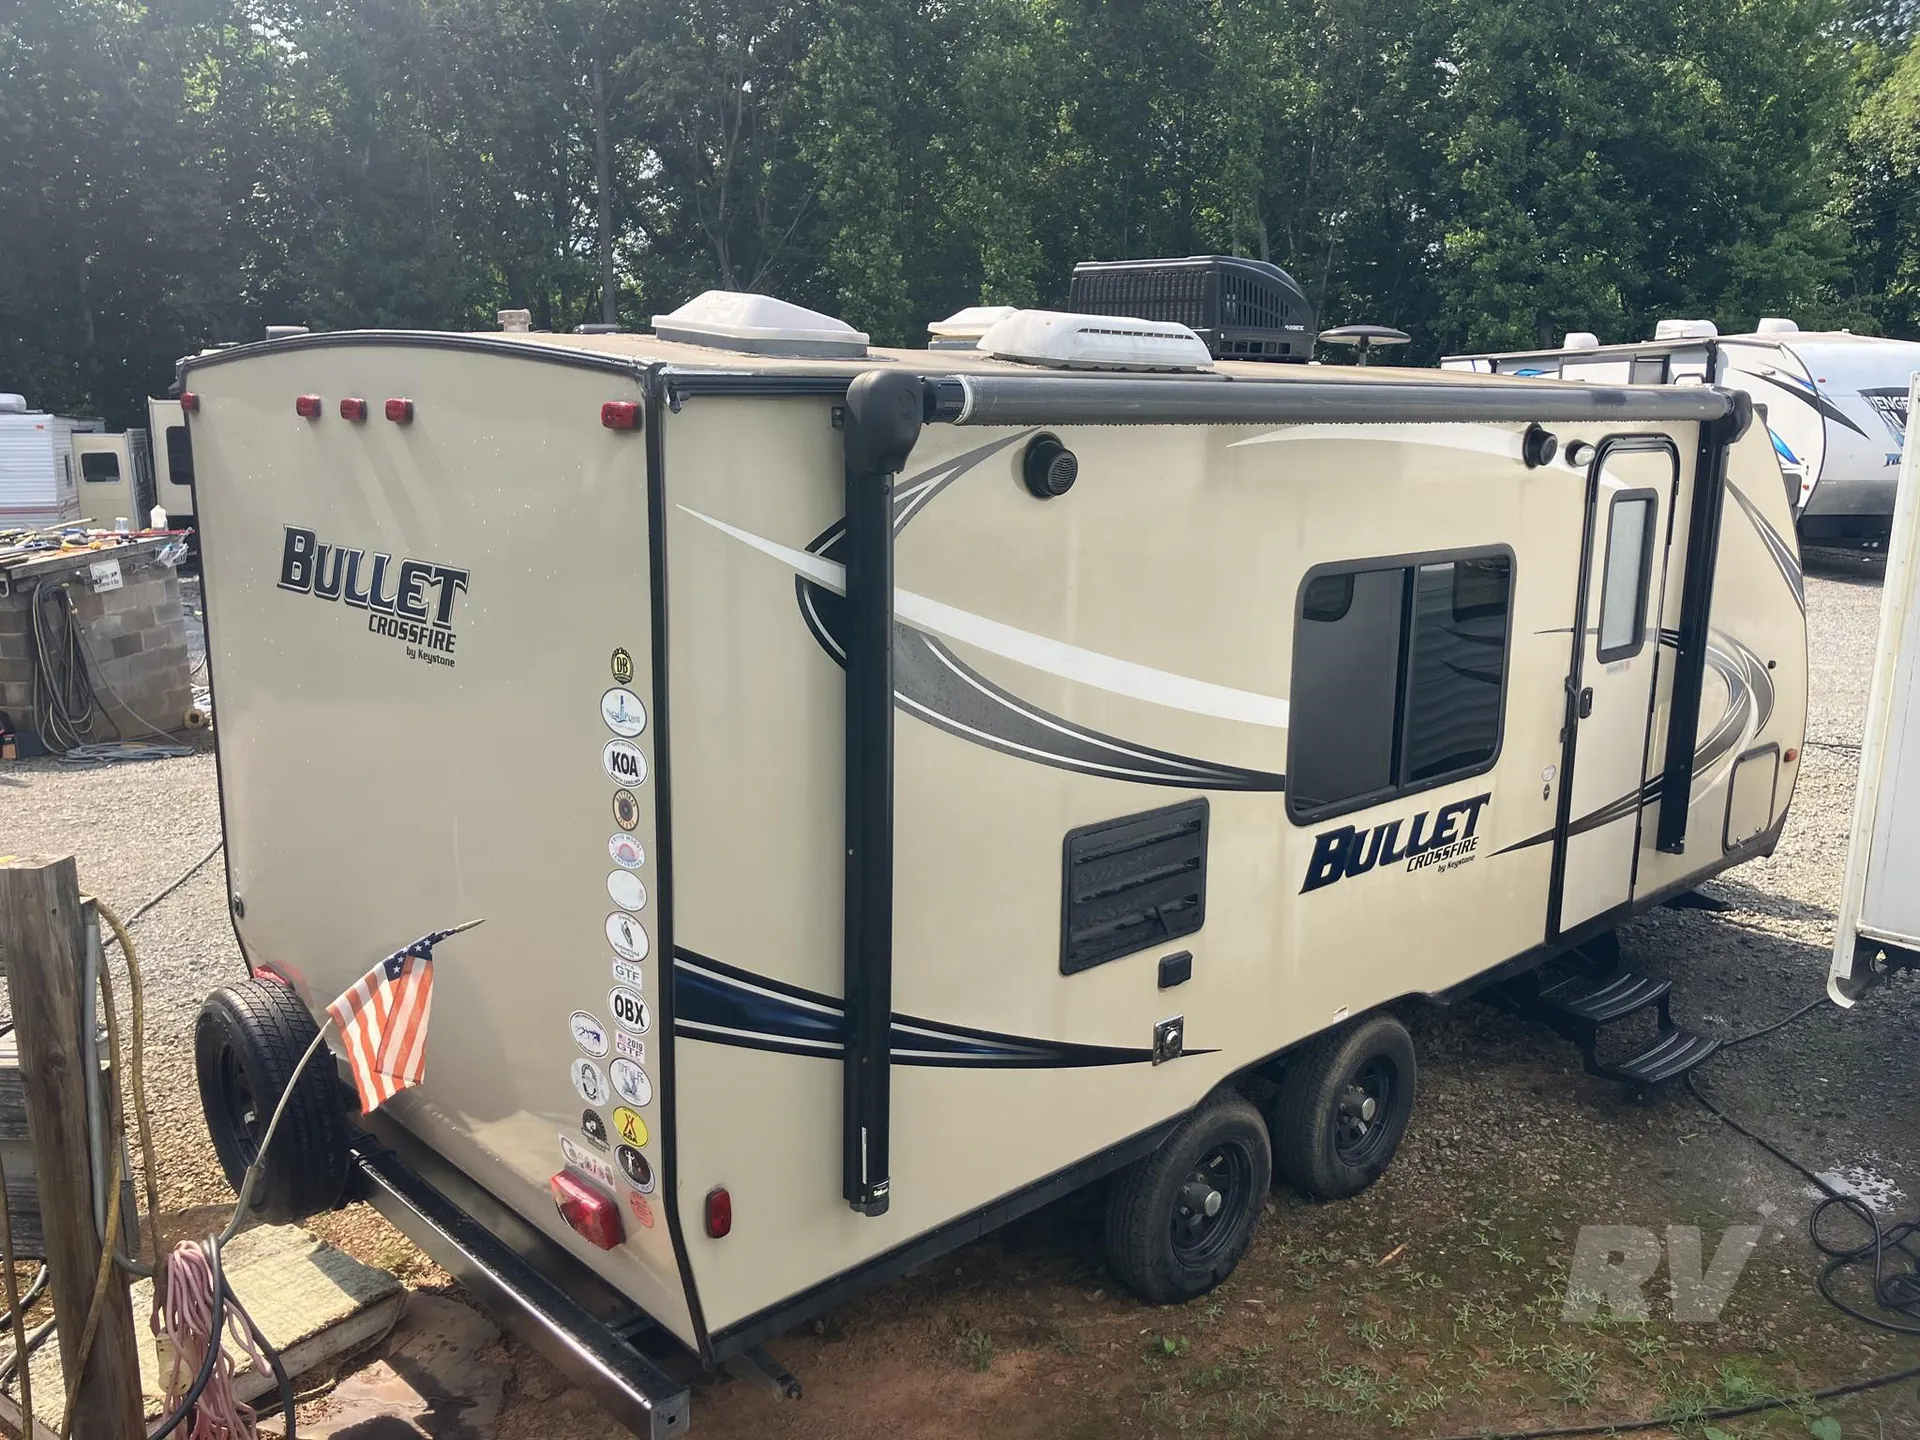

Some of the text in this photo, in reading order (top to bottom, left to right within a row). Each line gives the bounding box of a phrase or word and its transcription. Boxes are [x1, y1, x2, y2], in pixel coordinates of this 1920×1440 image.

[277, 524, 470, 631] BULLET
[368, 614, 457, 653] CROSSFIRE
[406, 646, 455, 668] by Keystone
[616, 656, 628, 675] DB
[611, 751, 639, 777] KOA
[1297, 791, 1492, 895] BULLET
[1406, 836, 1479, 873] CROSSFIRE
[1437, 854, 1475, 873] by Keystone
[615, 964, 639, 981] GTF
[615, 994, 645, 1027] OBX
[617, 1042, 644, 1057] GTF
[627, 1037, 643, 1052] 2019
[623, 1131, 638, 1144] KOA
